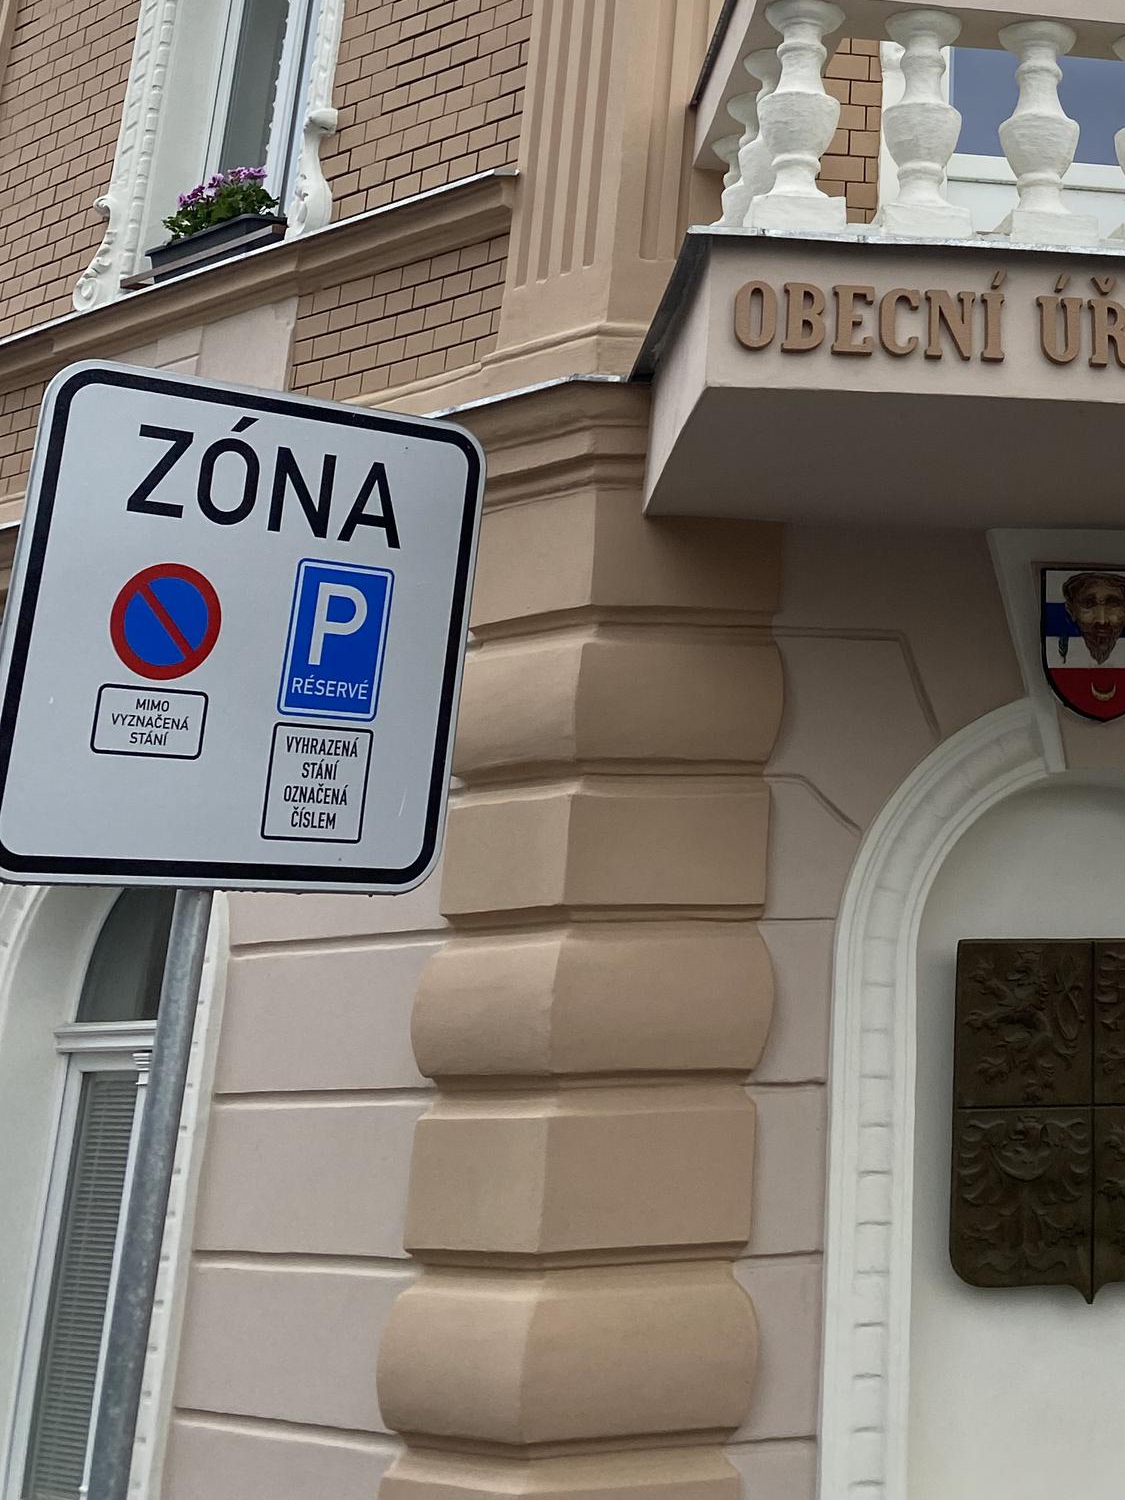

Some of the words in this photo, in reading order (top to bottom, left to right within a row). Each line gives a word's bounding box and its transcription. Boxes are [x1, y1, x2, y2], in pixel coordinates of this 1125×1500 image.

[733, 269, 1007, 363] OBECNÍ
[126, 416, 401, 549] ZÓNA
[308, 582, 368, 666] P
[291, 675, 369, 700] RÉSERVÉ
[135, 698, 170, 712] MIMO
[111, 713, 189, 731] VYZNAČENÁ
[129, 730, 169, 746] STÁNÍ
[286, 736, 360, 758] VYHRAZENÁ
[301, 759, 340, 780] STÁNÍ
[283, 783, 349, 805] OZNAČENÁ
[290, 806, 337, 830] ČÍSLEM
